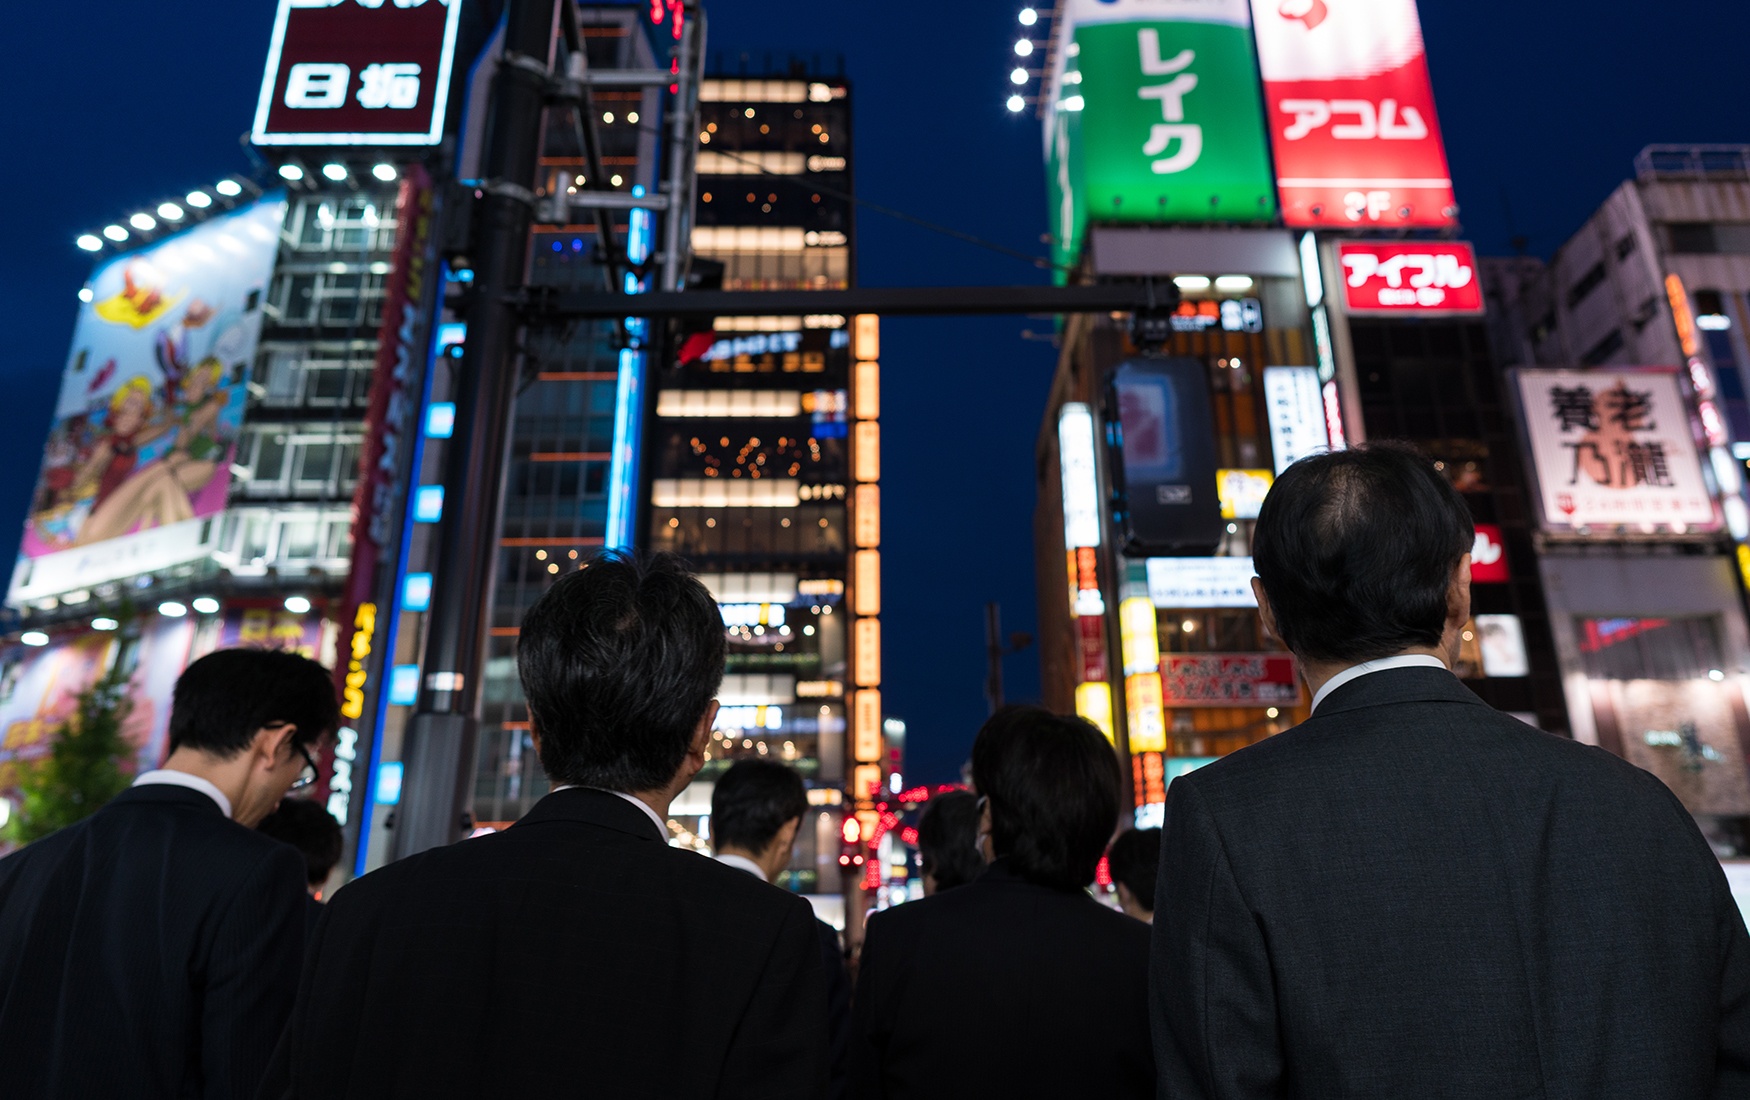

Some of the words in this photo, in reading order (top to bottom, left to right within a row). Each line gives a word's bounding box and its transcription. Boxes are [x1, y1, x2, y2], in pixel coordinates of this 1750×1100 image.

[284, 63, 422, 109] 日拓
[1138, 28, 1202, 174] レイク
[1280, 99, 1428, 140] アコム
[1342, 254, 1471, 288] アイフル
[1549, 384, 1656, 432] 養老
[327, 726, 358, 826] エスパ
